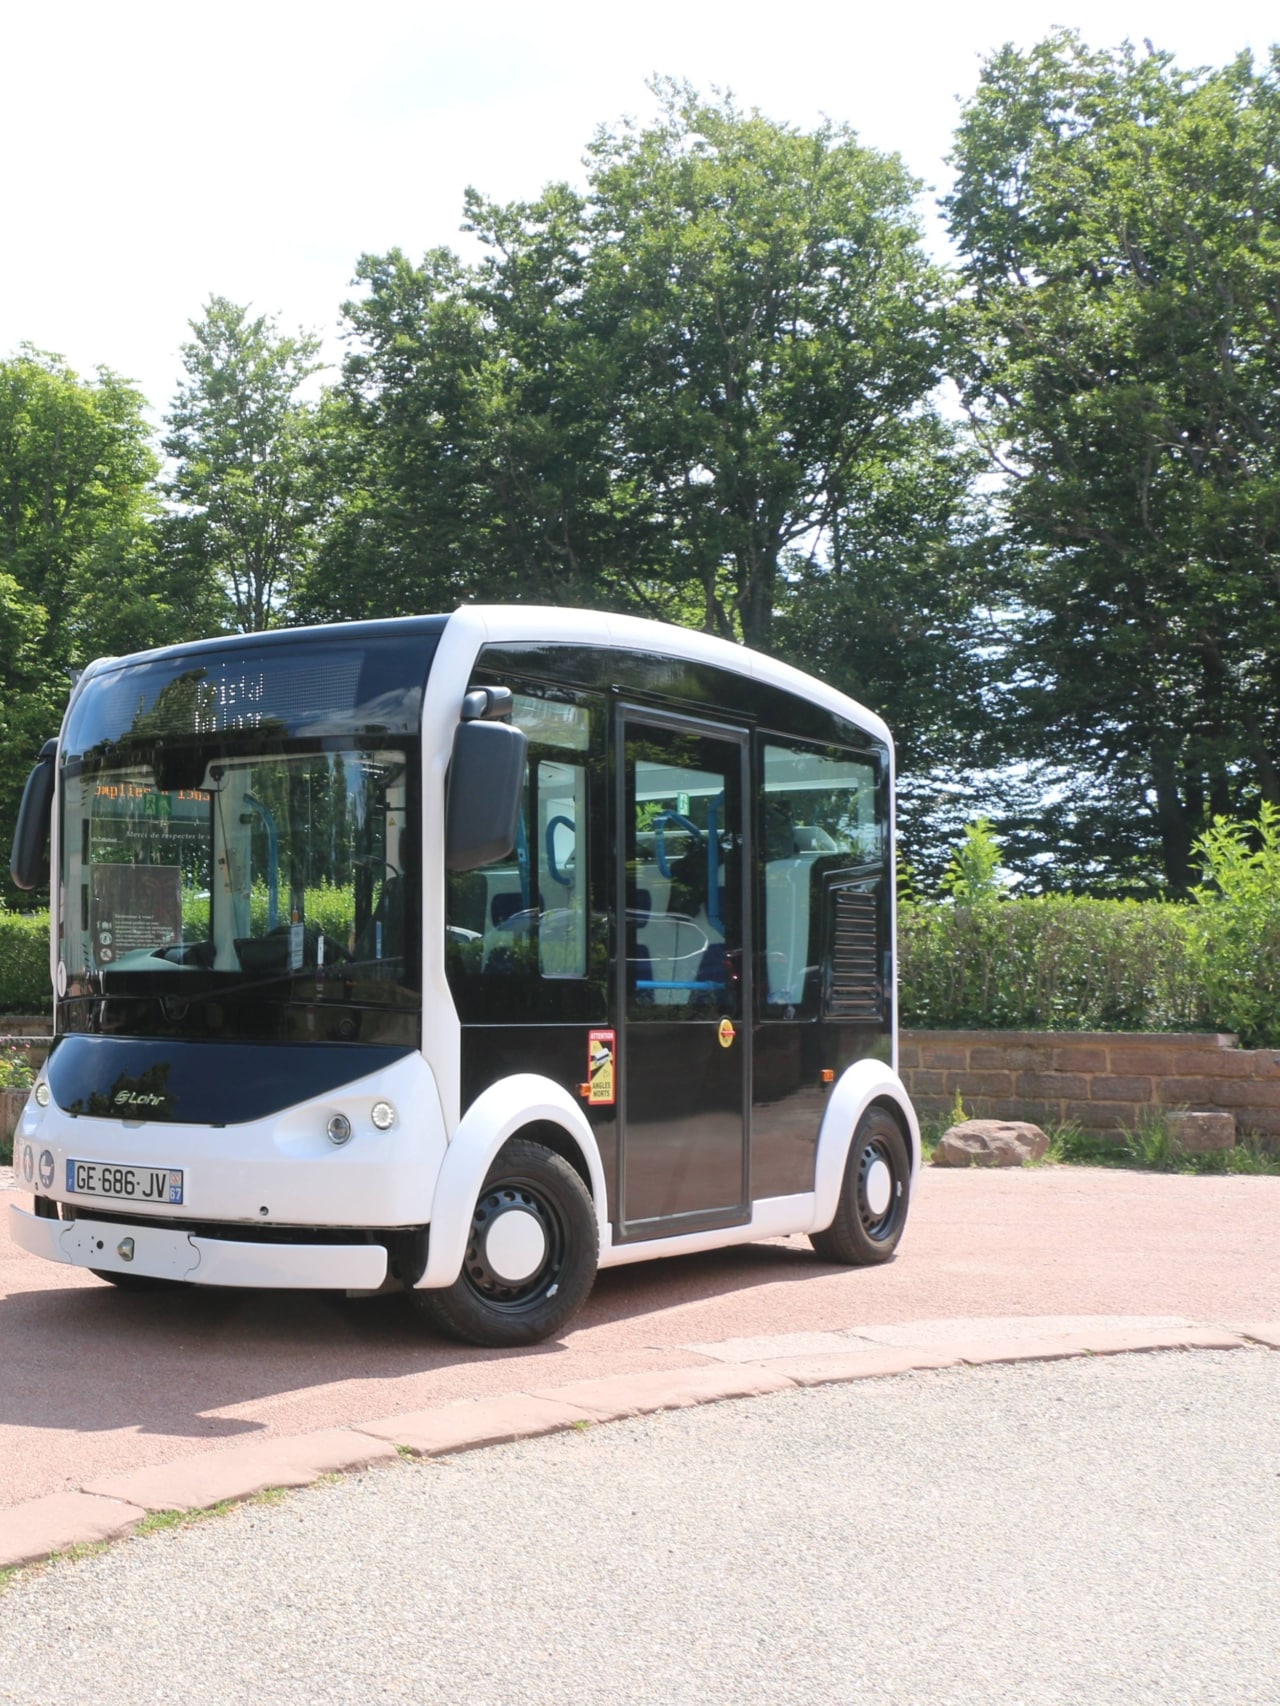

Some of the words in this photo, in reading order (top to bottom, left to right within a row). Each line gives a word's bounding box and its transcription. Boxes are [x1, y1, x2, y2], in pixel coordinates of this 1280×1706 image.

[126, 831, 148, 839] Merci
[150, 831, 159, 839] de
[128, 1092, 165, 1105] Lohr
[170, 1187, 182, 1200] 67
